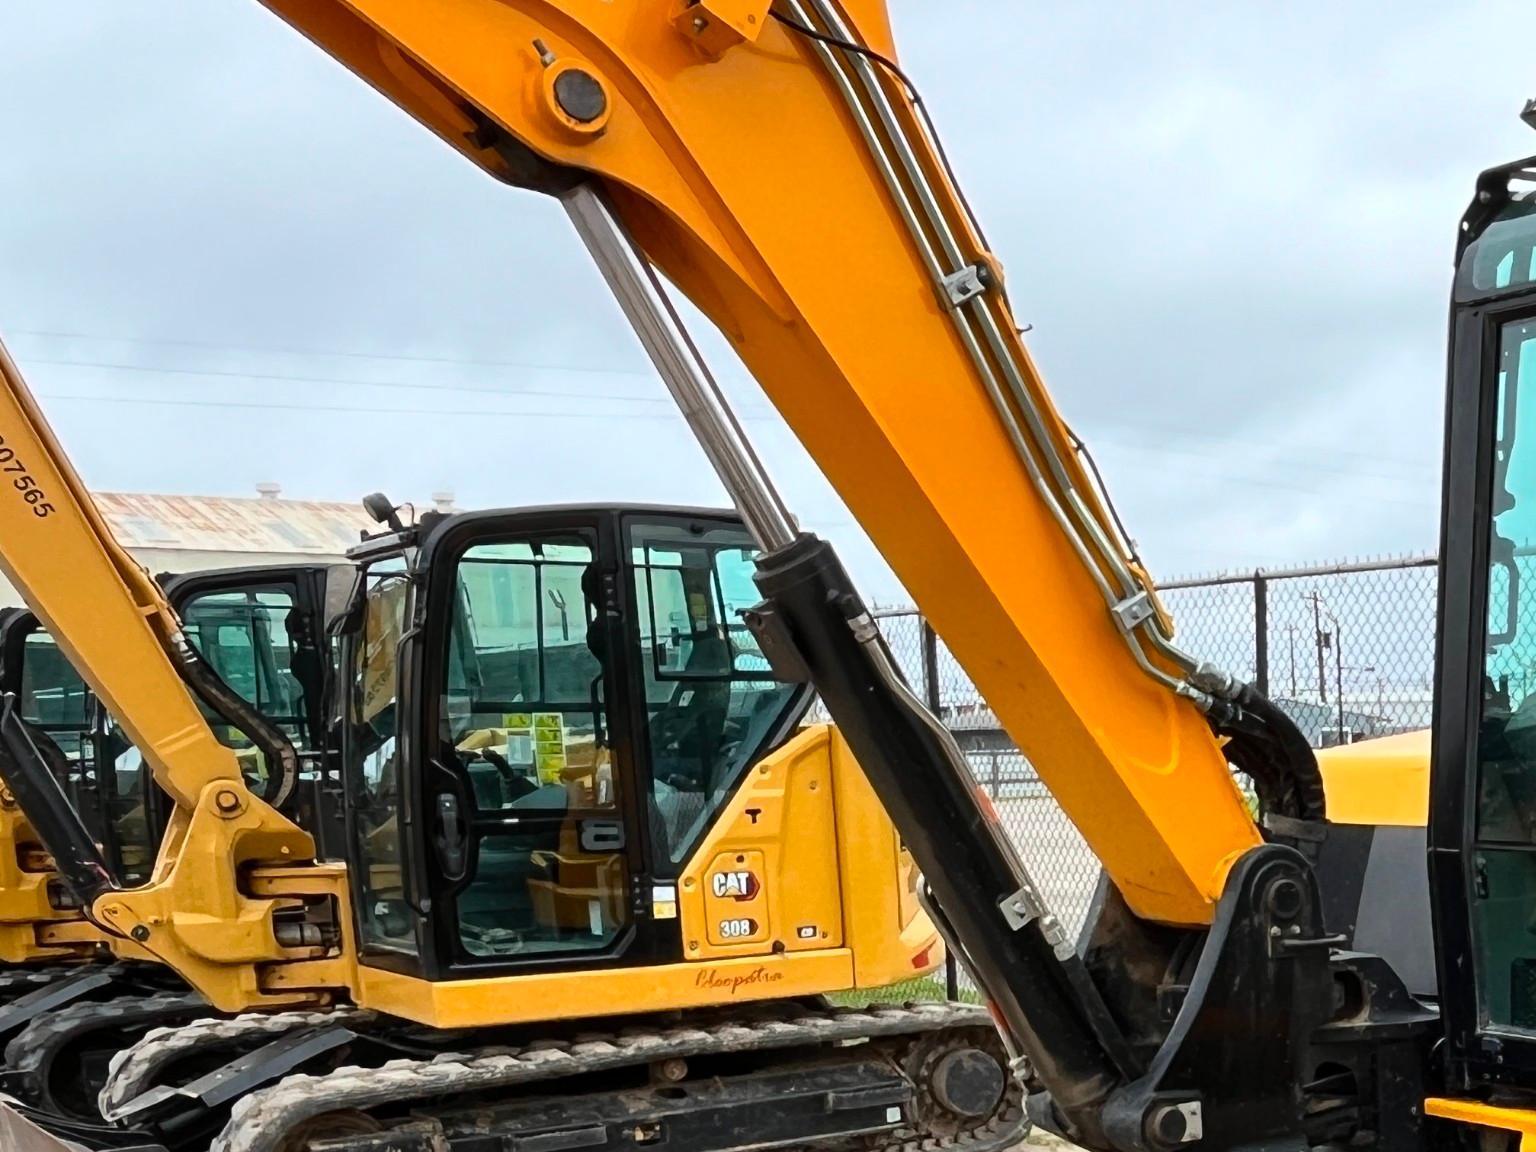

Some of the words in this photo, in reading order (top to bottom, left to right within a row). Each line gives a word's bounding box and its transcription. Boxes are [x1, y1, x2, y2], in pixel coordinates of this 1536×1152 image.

[0, 435, 56, 518] 07565
[713, 872, 749, 896] CAT
[719, 919, 751, 937] 308
